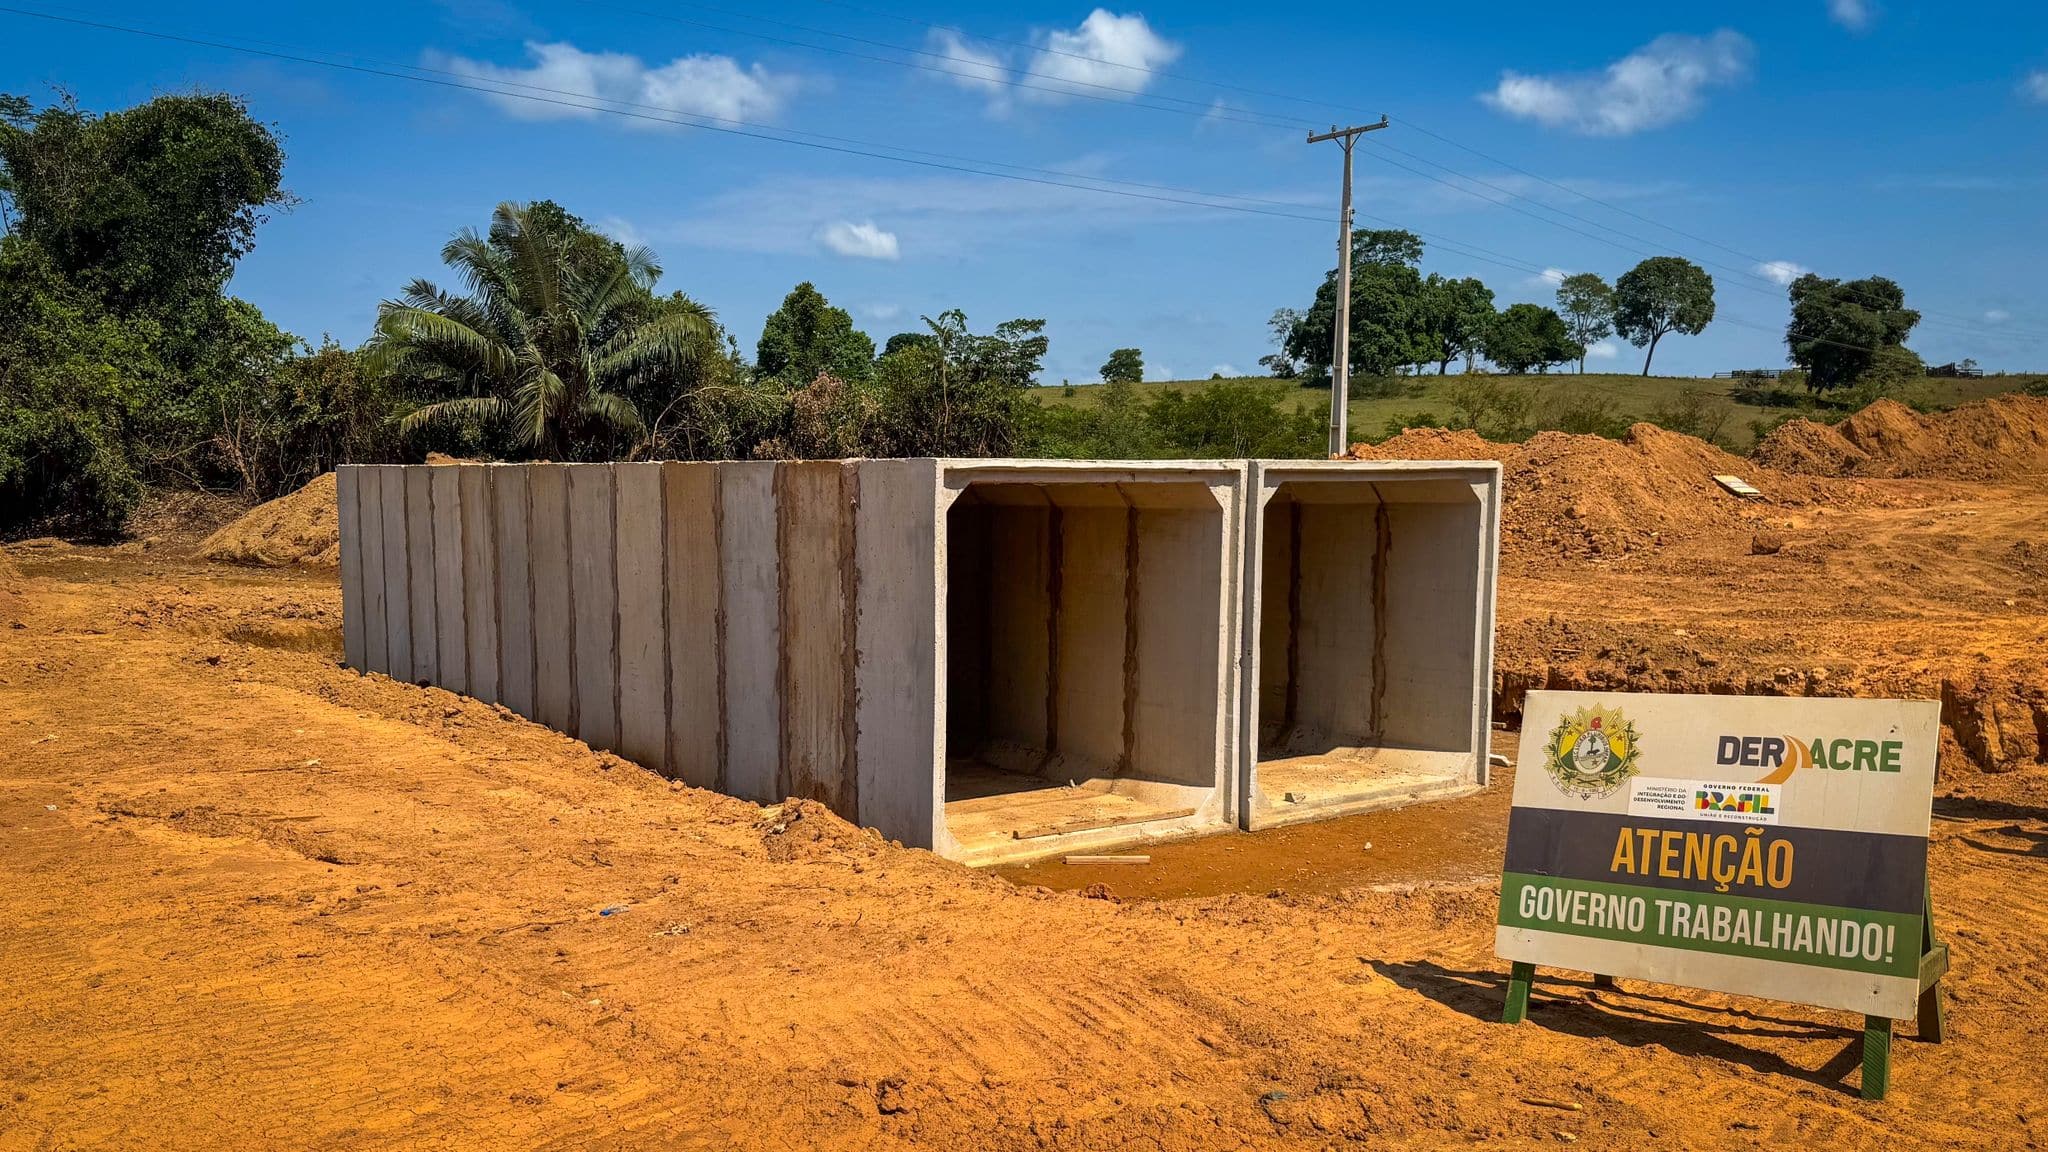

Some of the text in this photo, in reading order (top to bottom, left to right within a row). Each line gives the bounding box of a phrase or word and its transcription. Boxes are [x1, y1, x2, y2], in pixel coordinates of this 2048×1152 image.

[1717, 735, 1903, 772] DER ACRE
[1633, 797, 1685, 805] DESENVOLVIMENTO
[1695, 790, 1775, 814] BRASIL
[1611, 827, 1795, 892] ATENÇÃO
[1519, 884, 1895, 963] GOVERNO TRABALHANDO!
